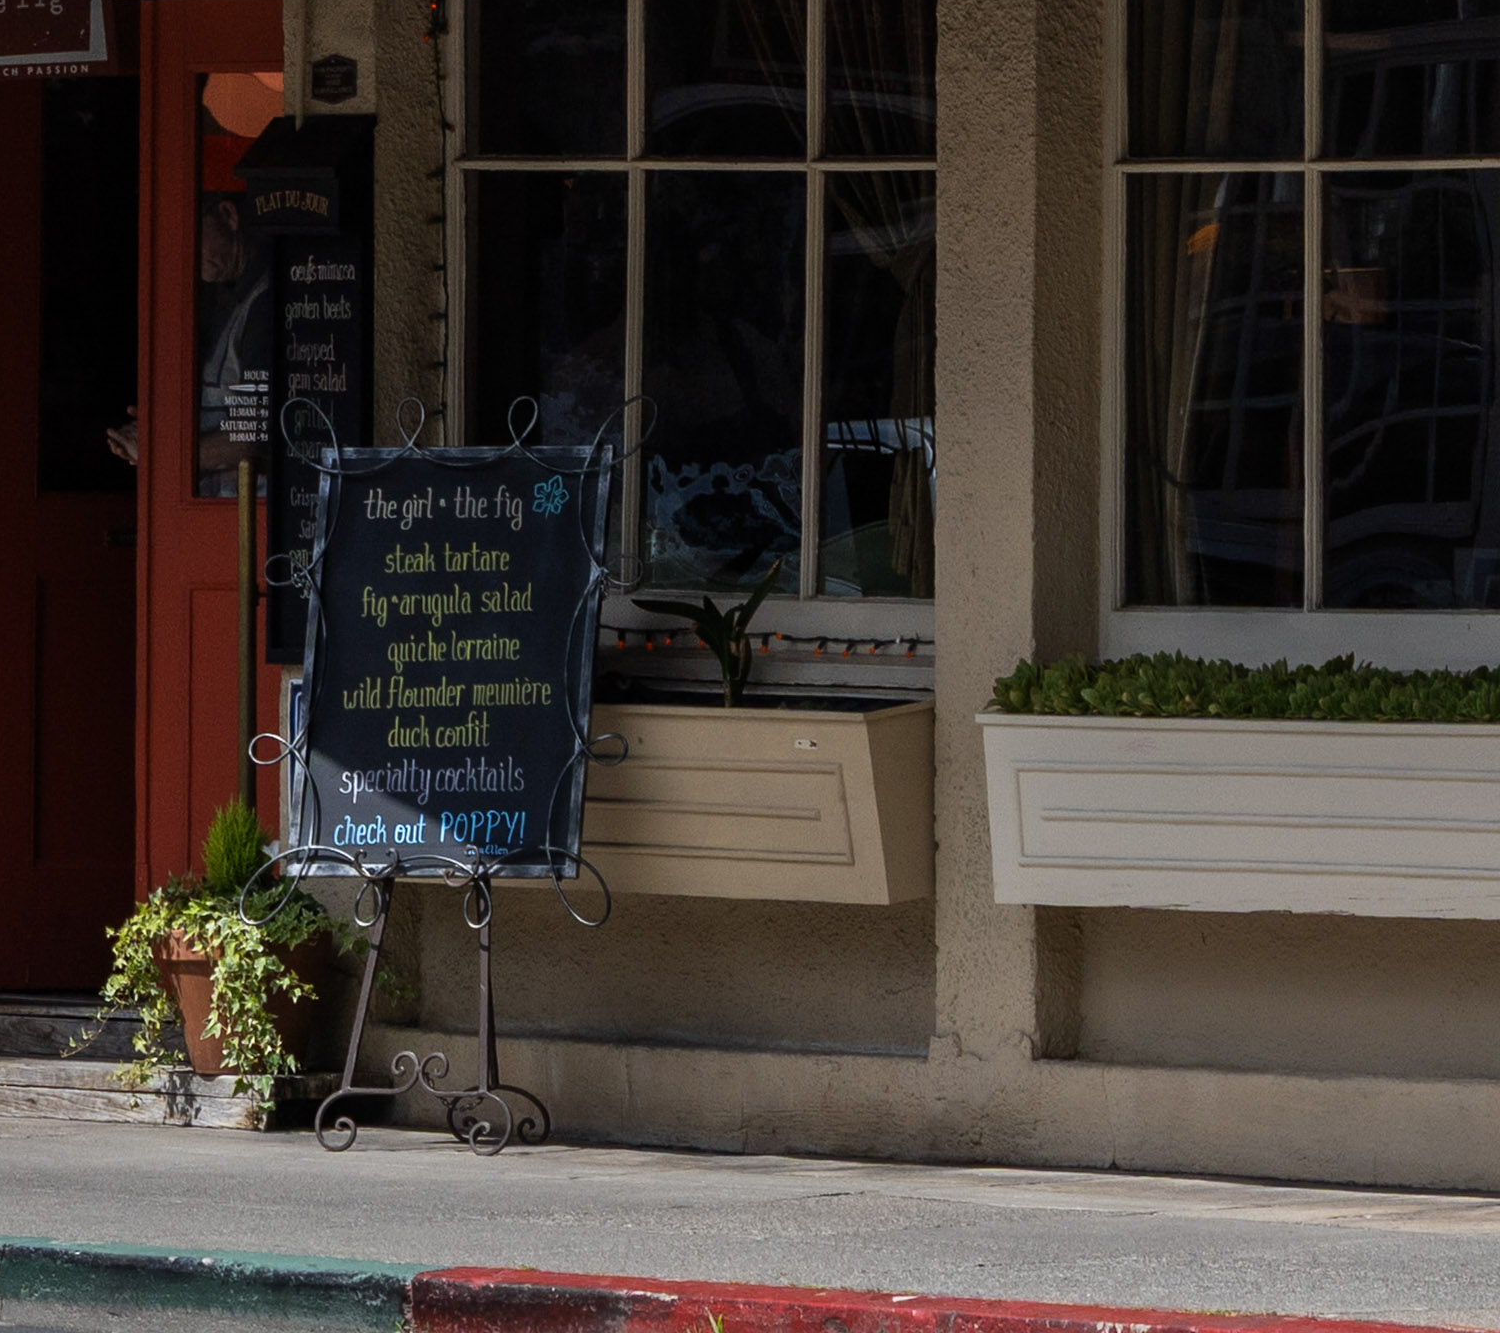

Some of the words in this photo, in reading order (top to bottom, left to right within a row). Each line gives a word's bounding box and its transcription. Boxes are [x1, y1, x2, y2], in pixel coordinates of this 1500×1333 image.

[27, 64, 90, 76] PASSION
[255, 192, 283, 216] PLAT
[285, 190, 300, 208] DU
[301, 192, 329, 217] JOUR
[285, 293, 320, 330] garden
[323, 293, 351, 321] beets
[286, 332, 336, 367] chopped
[288, 372, 311, 398] gem
[313, 362, 347, 392] salad
[223, 395, 257, 406] MONDAY
[220, 420, 257, 431] SATURDAY
[364, 488, 397, 519] the
[400, 487, 433, 530] girl
[454, 486, 487, 518] the
[494, 485, 522, 531] fig
[384, 542, 436, 574] steak
[444, 541, 510, 573] tartare
[361, 586, 387, 627] fig
[399, 583, 472, 627] arugula
[480, 582, 533, 613] salad
[387, 630, 447, 673] quiche
[452, 630, 520, 661] lorraine
[343, 677, 381, 709] wild
[386, 675, 466, 708] flounder
[472, 677, 551, 706] meunière
[388, 715, 431, 748] duck
[435, 711, 490, 748] confit
[339, 758, 431, 805] specialty
[435, 756, 525, 793] cocktails
[333, 815, 387, 846] check
[394, 814, 427, 844] out
[439, 810, 526, 845] POPPY!
